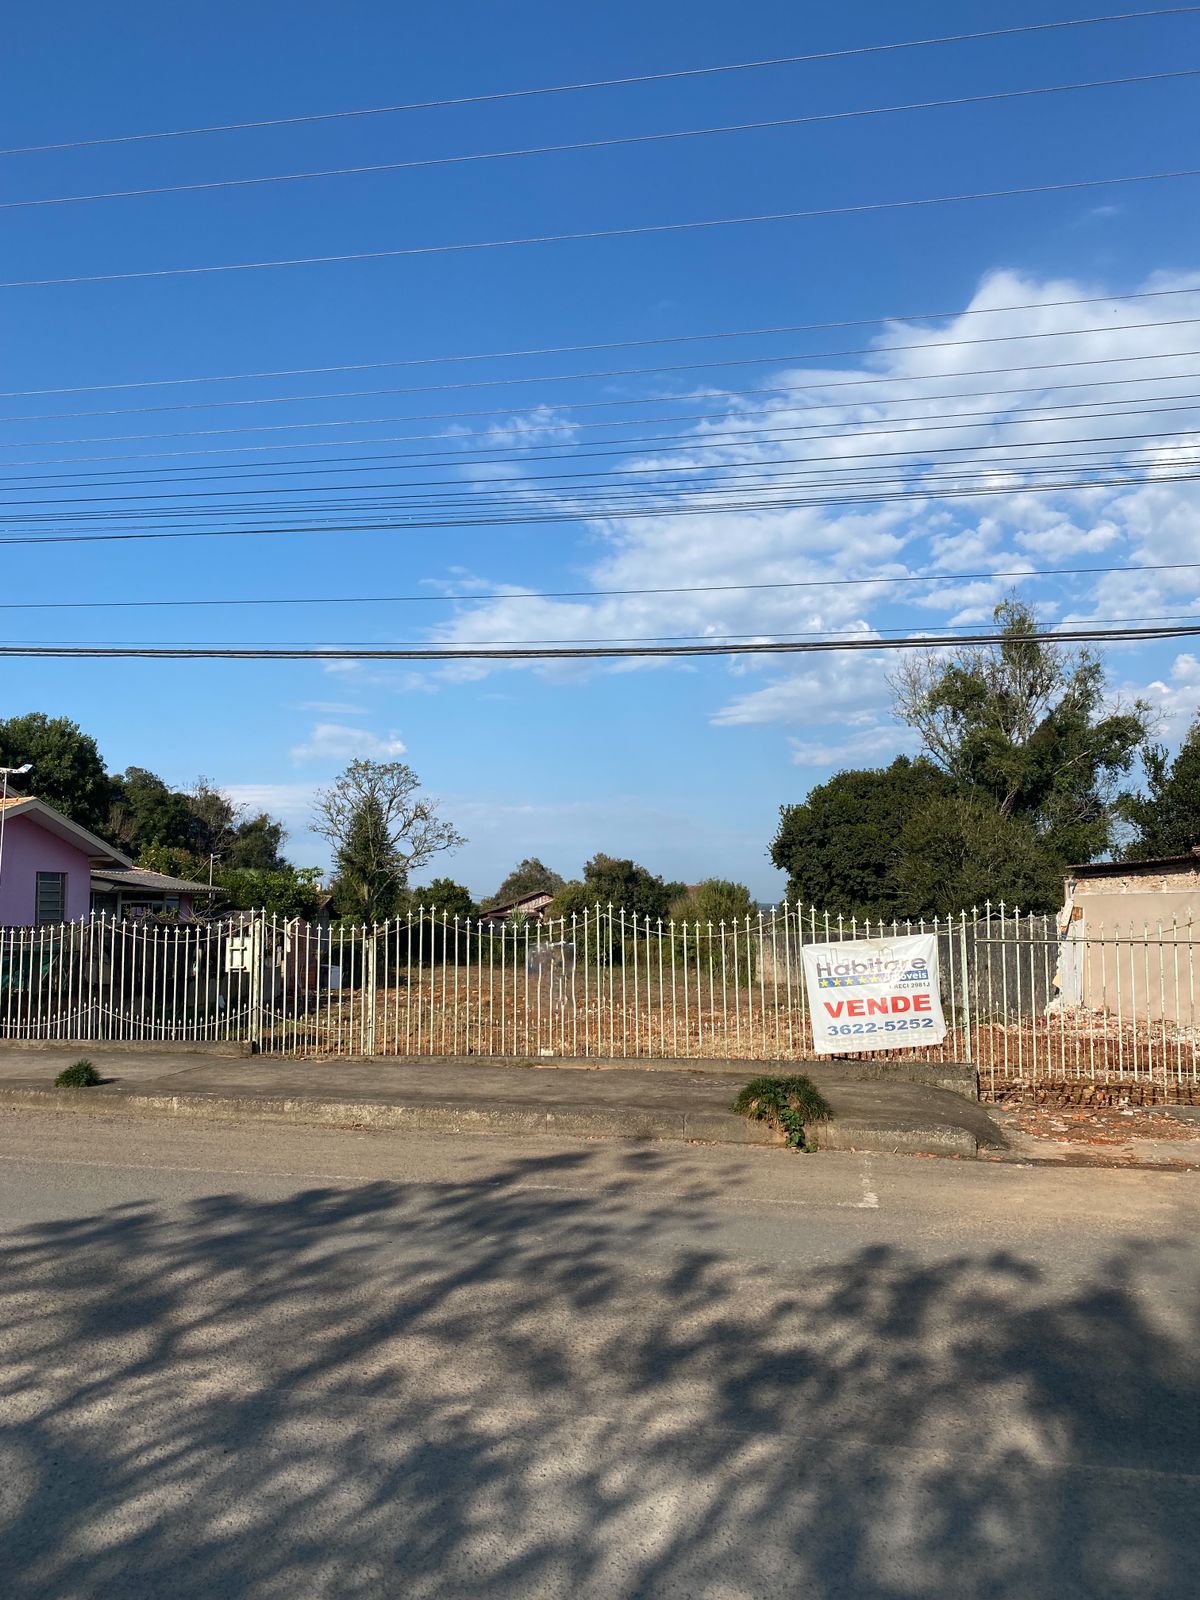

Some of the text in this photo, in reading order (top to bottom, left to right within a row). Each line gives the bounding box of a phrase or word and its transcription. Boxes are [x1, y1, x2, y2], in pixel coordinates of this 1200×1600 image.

[816, 957, 927, 977] Habitare
[823, 994, 932, 1018] VENDE
[827, 1018, 934, 1036] 3622-5252
